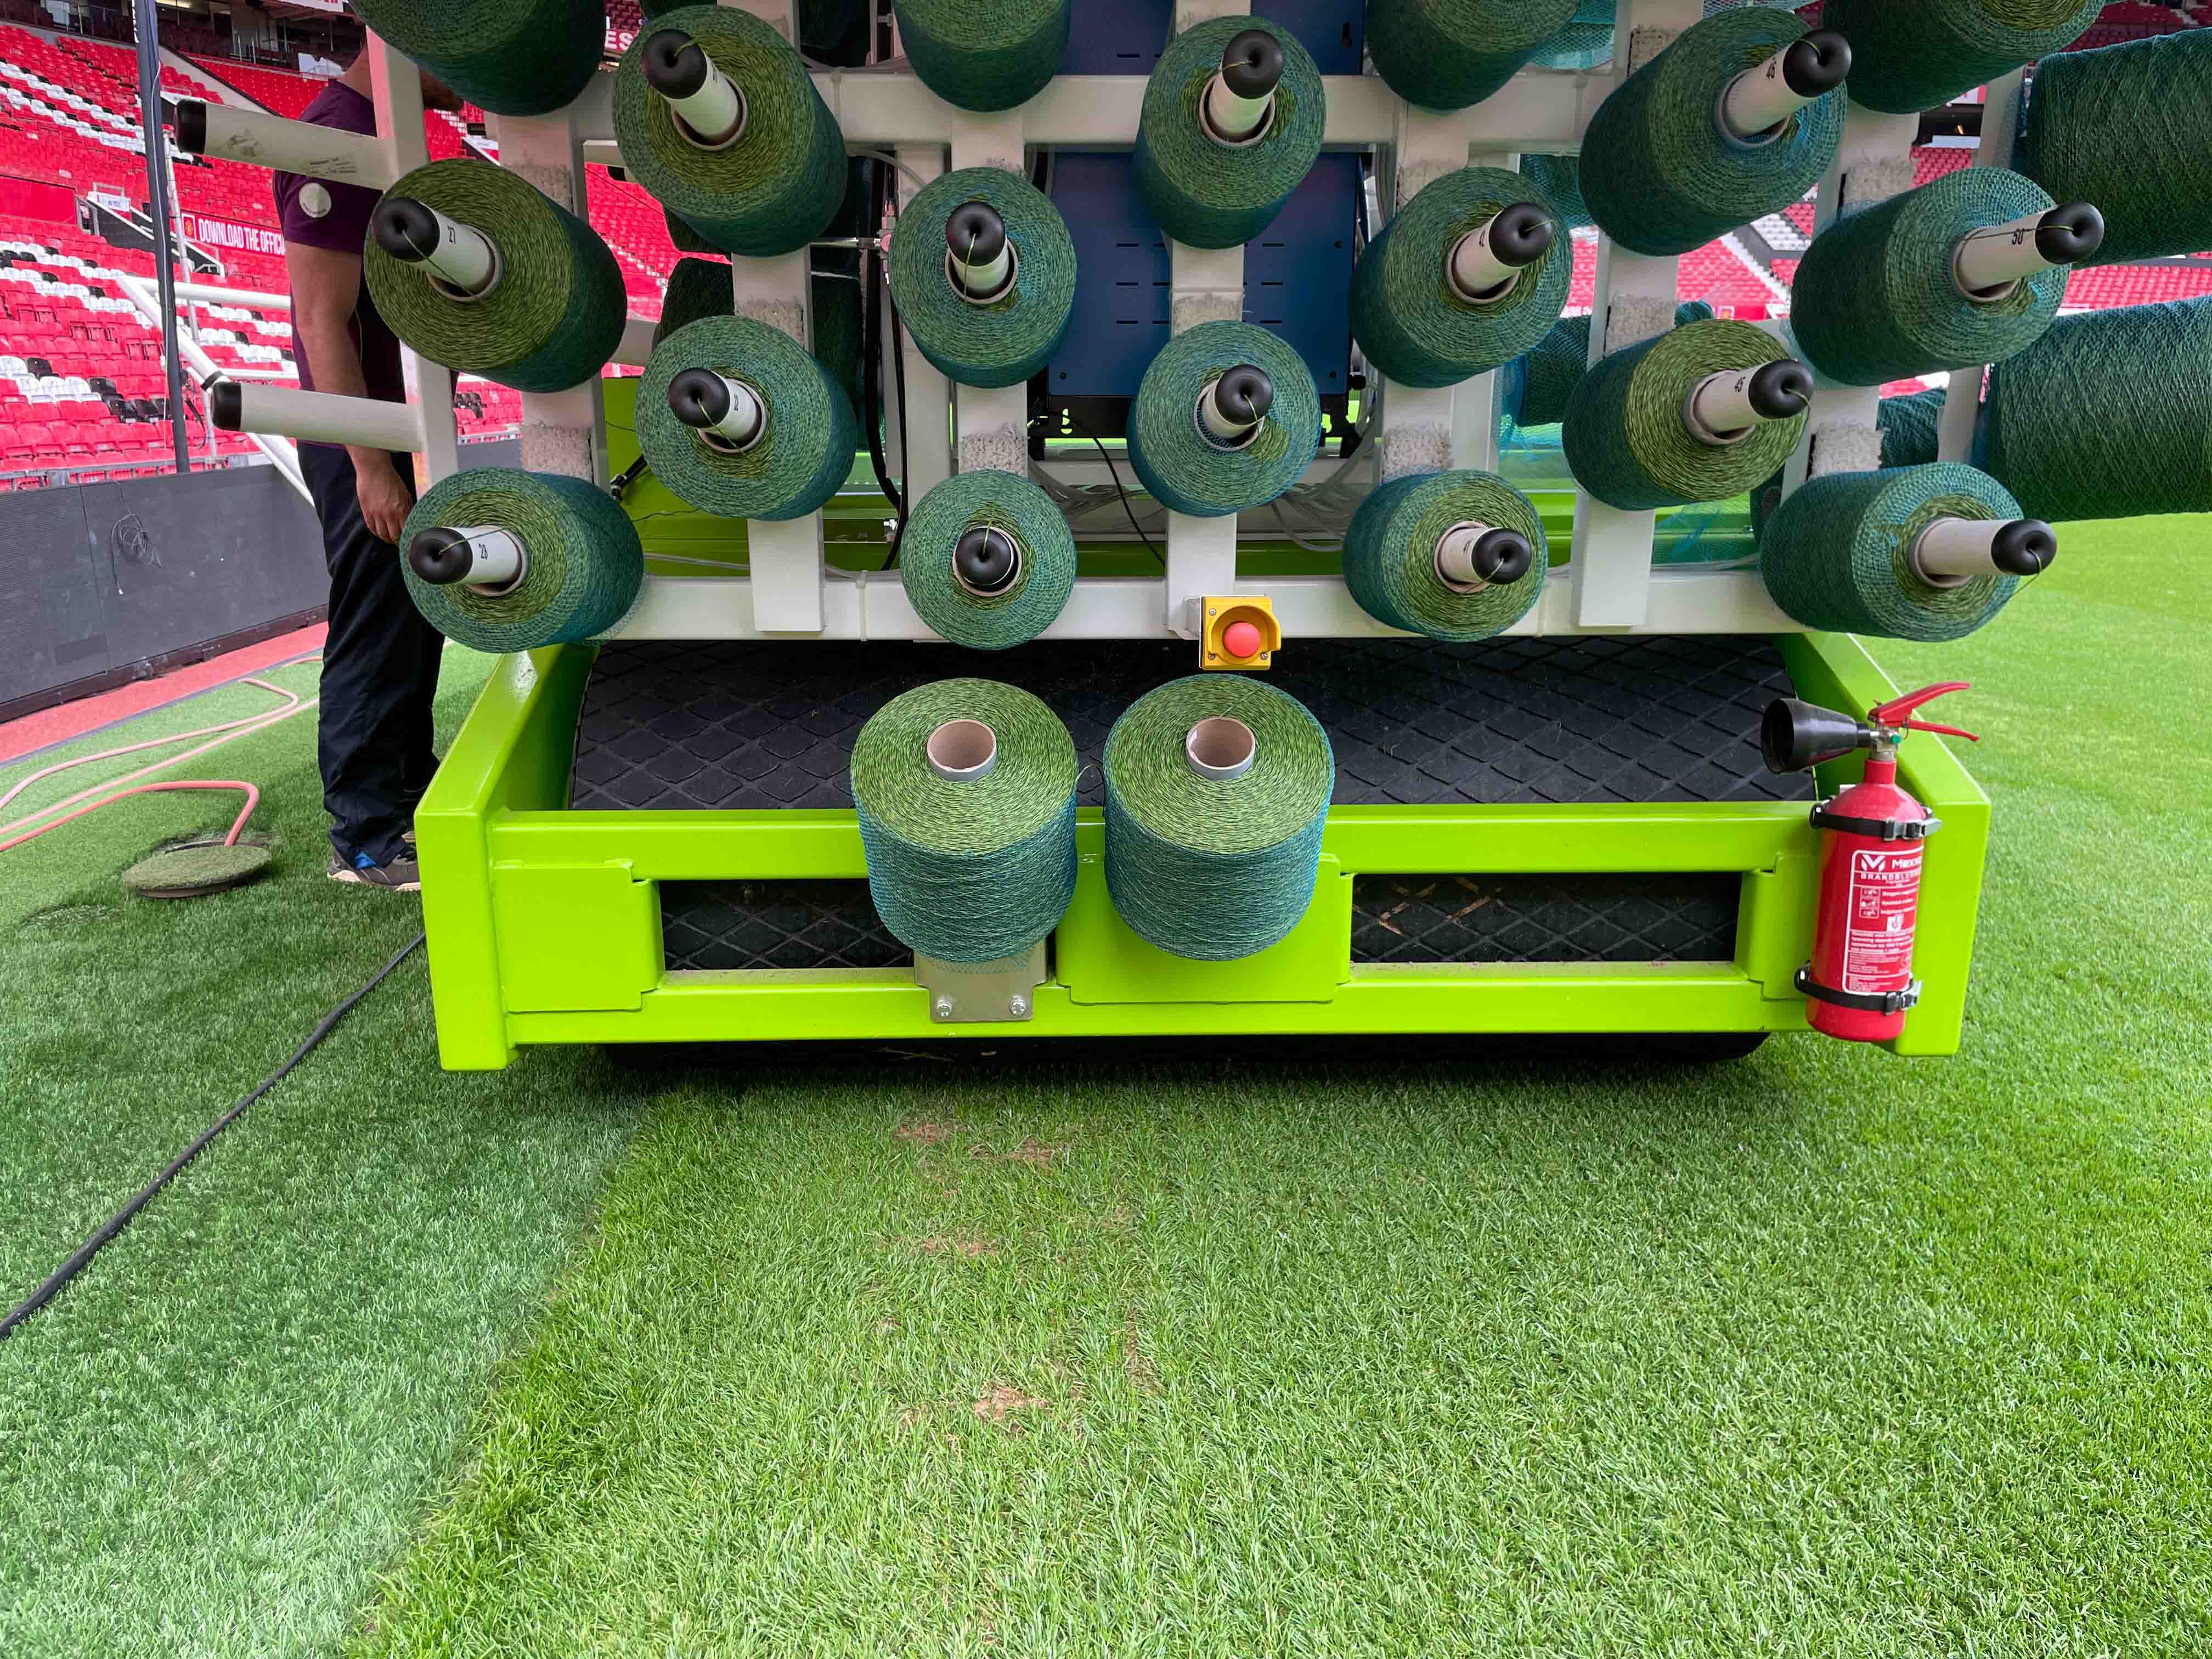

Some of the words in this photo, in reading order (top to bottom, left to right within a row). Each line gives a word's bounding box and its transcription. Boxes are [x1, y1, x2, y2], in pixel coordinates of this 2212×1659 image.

[198, 218, 244, 249] DOWNLOAD
[244, 227, 259, 251] THE
[447, 225, 456, 244] 27
[2011, 228, 2024, 245] 50
[478, 544, 488, 560] 28
